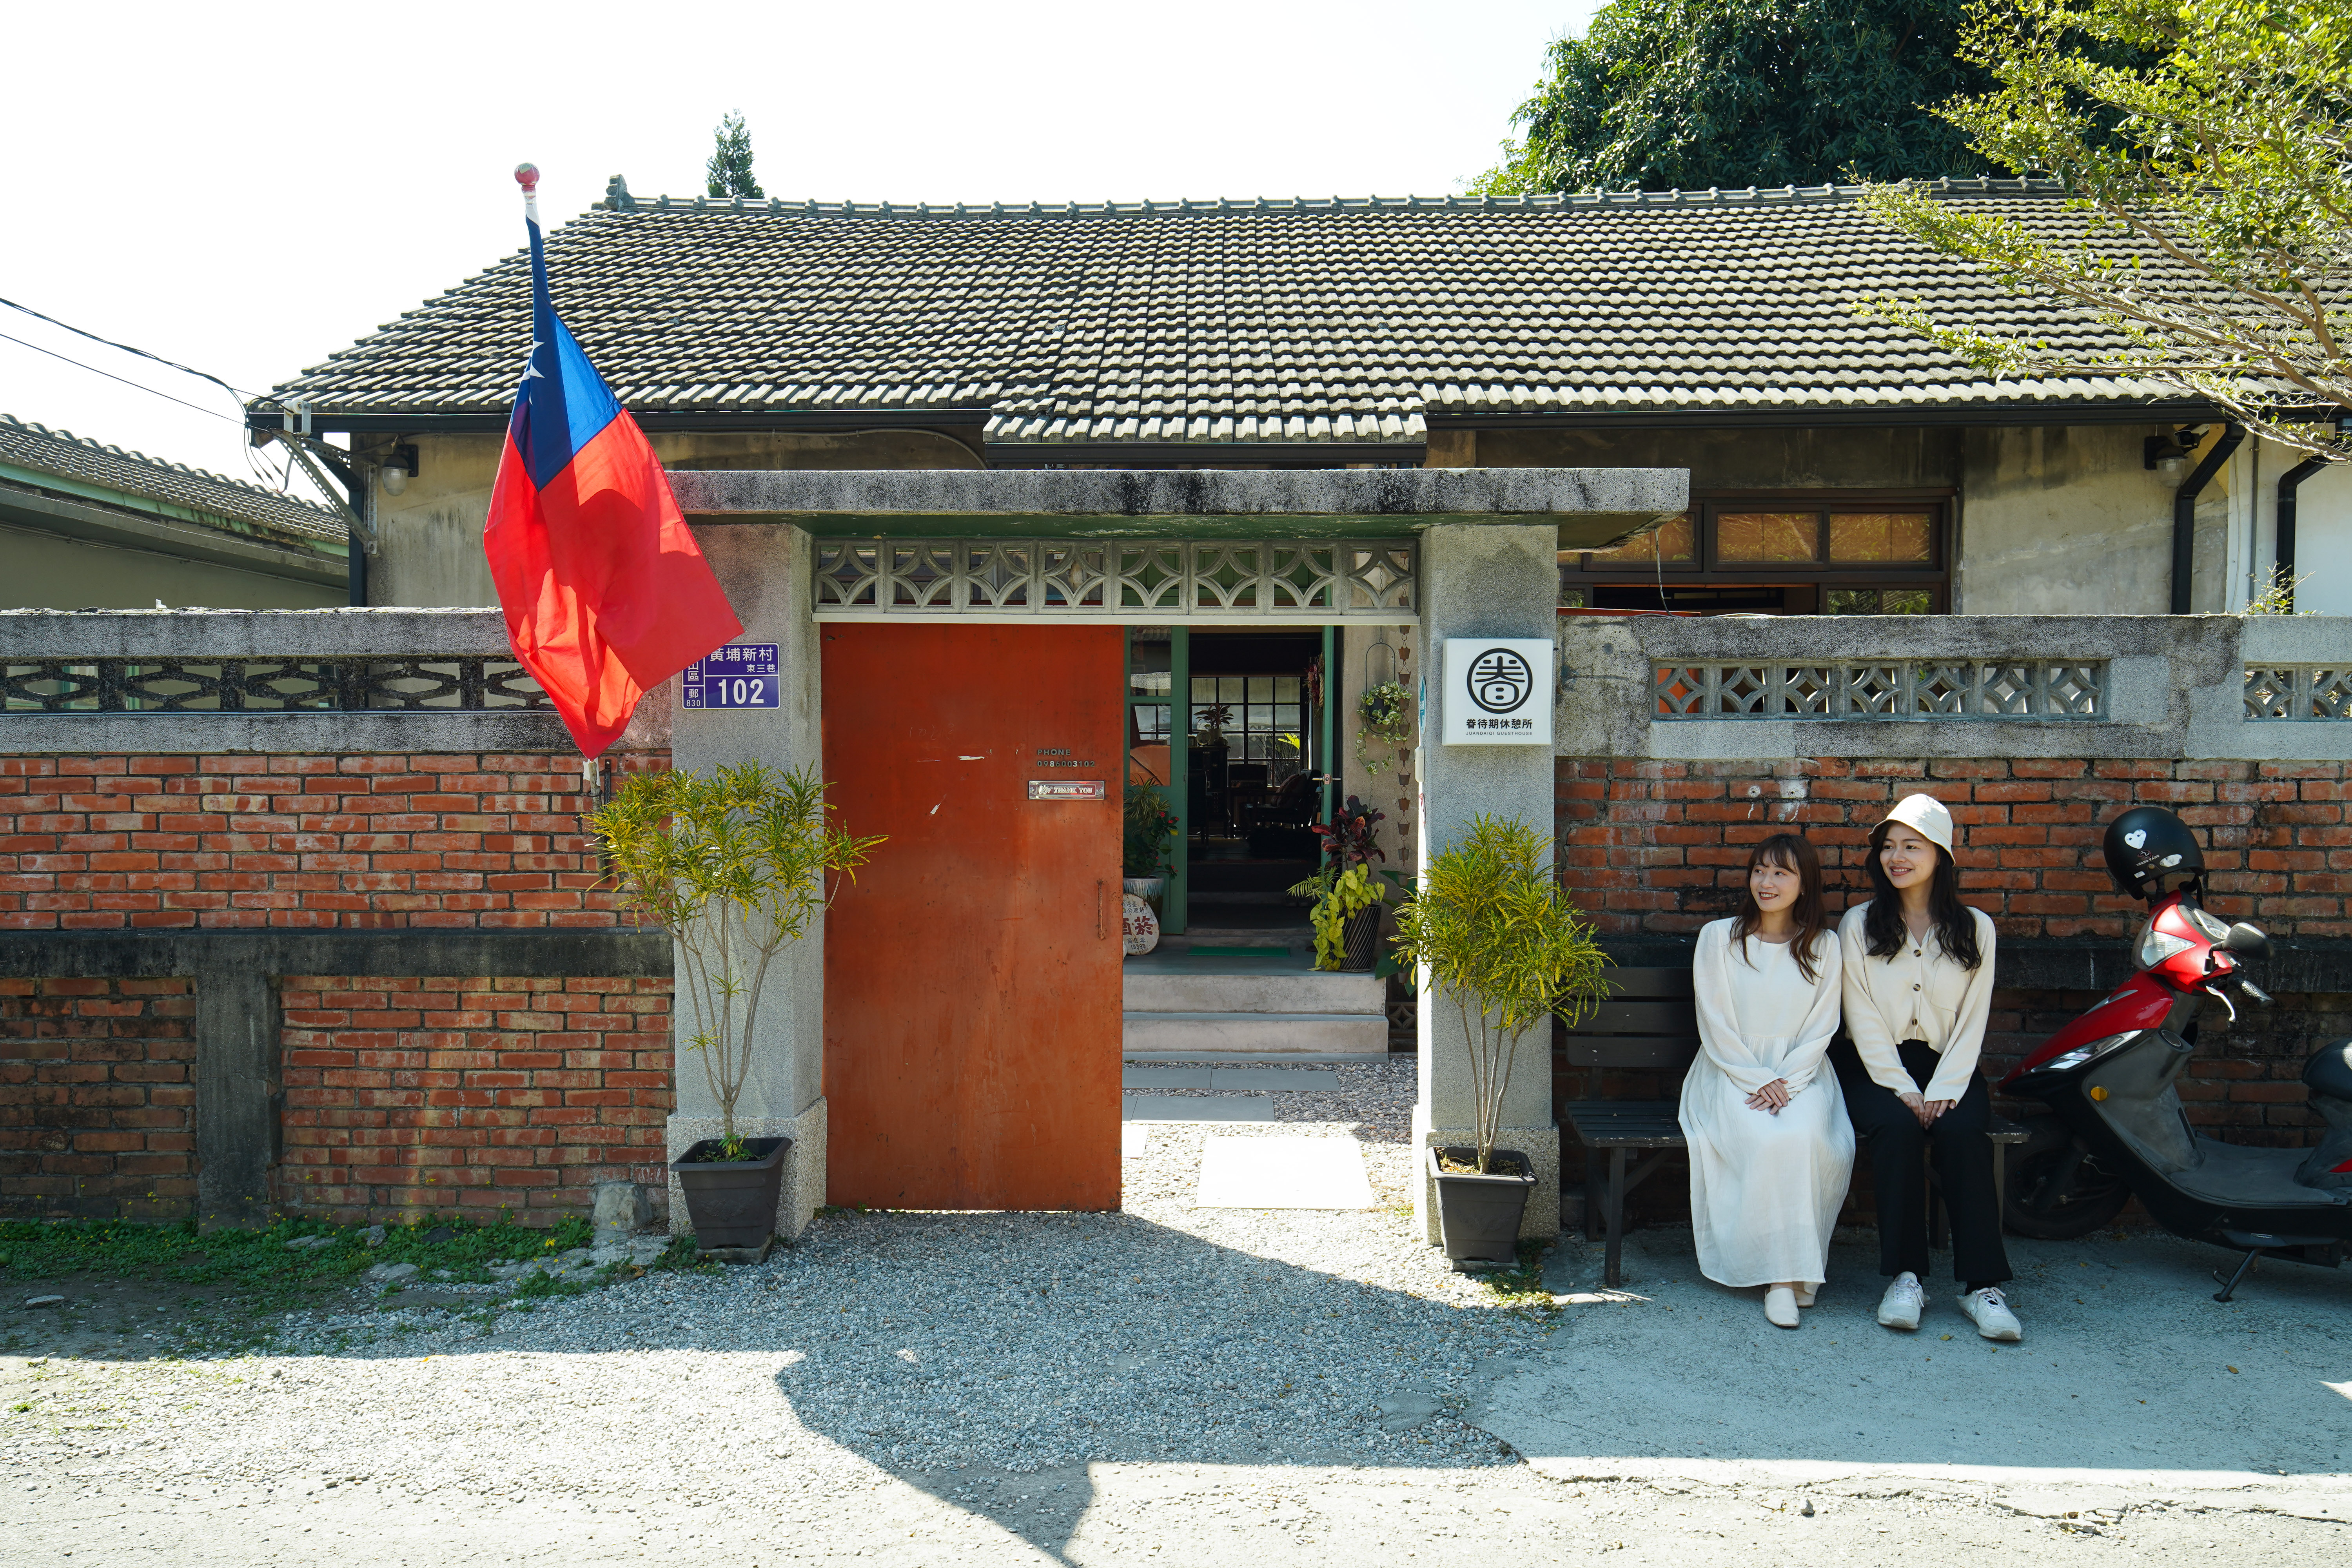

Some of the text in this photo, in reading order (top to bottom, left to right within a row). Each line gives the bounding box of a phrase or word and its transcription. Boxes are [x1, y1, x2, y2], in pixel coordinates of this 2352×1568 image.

[710, 647, 773, 661] 黃埔新村
[746, 664, 775, 673] 東三巷
[688, 688, 699, 698] 郵
[718, 679, 764, 704] 102
[1466, 719, 1532, 729] 眷待期休憩所
